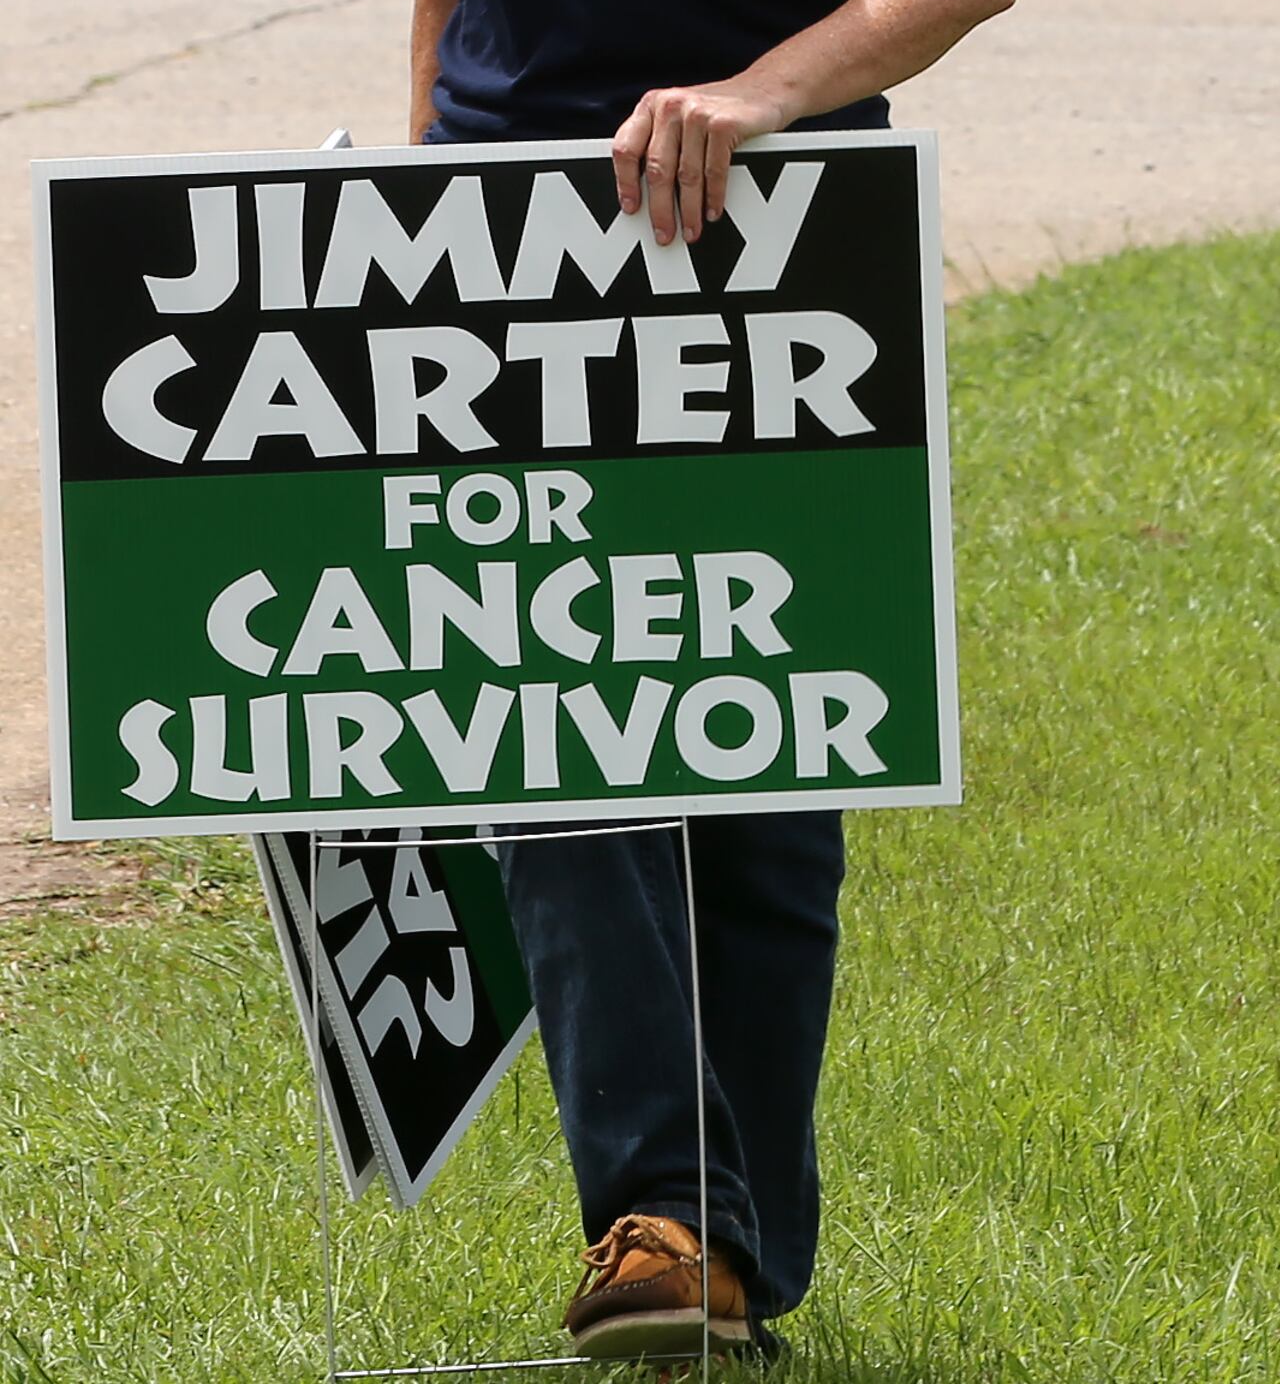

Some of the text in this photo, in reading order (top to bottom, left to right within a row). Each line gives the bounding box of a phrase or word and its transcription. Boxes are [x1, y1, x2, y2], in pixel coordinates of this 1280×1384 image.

[143, 161, 823, 314] JIMMY
[102, 311, 877, 463] CARTER
[384, 471, 592, 549] FOR
[207, 552, 793, 677] CANCER
[119, 671, 888, 806] SURVIVOR
